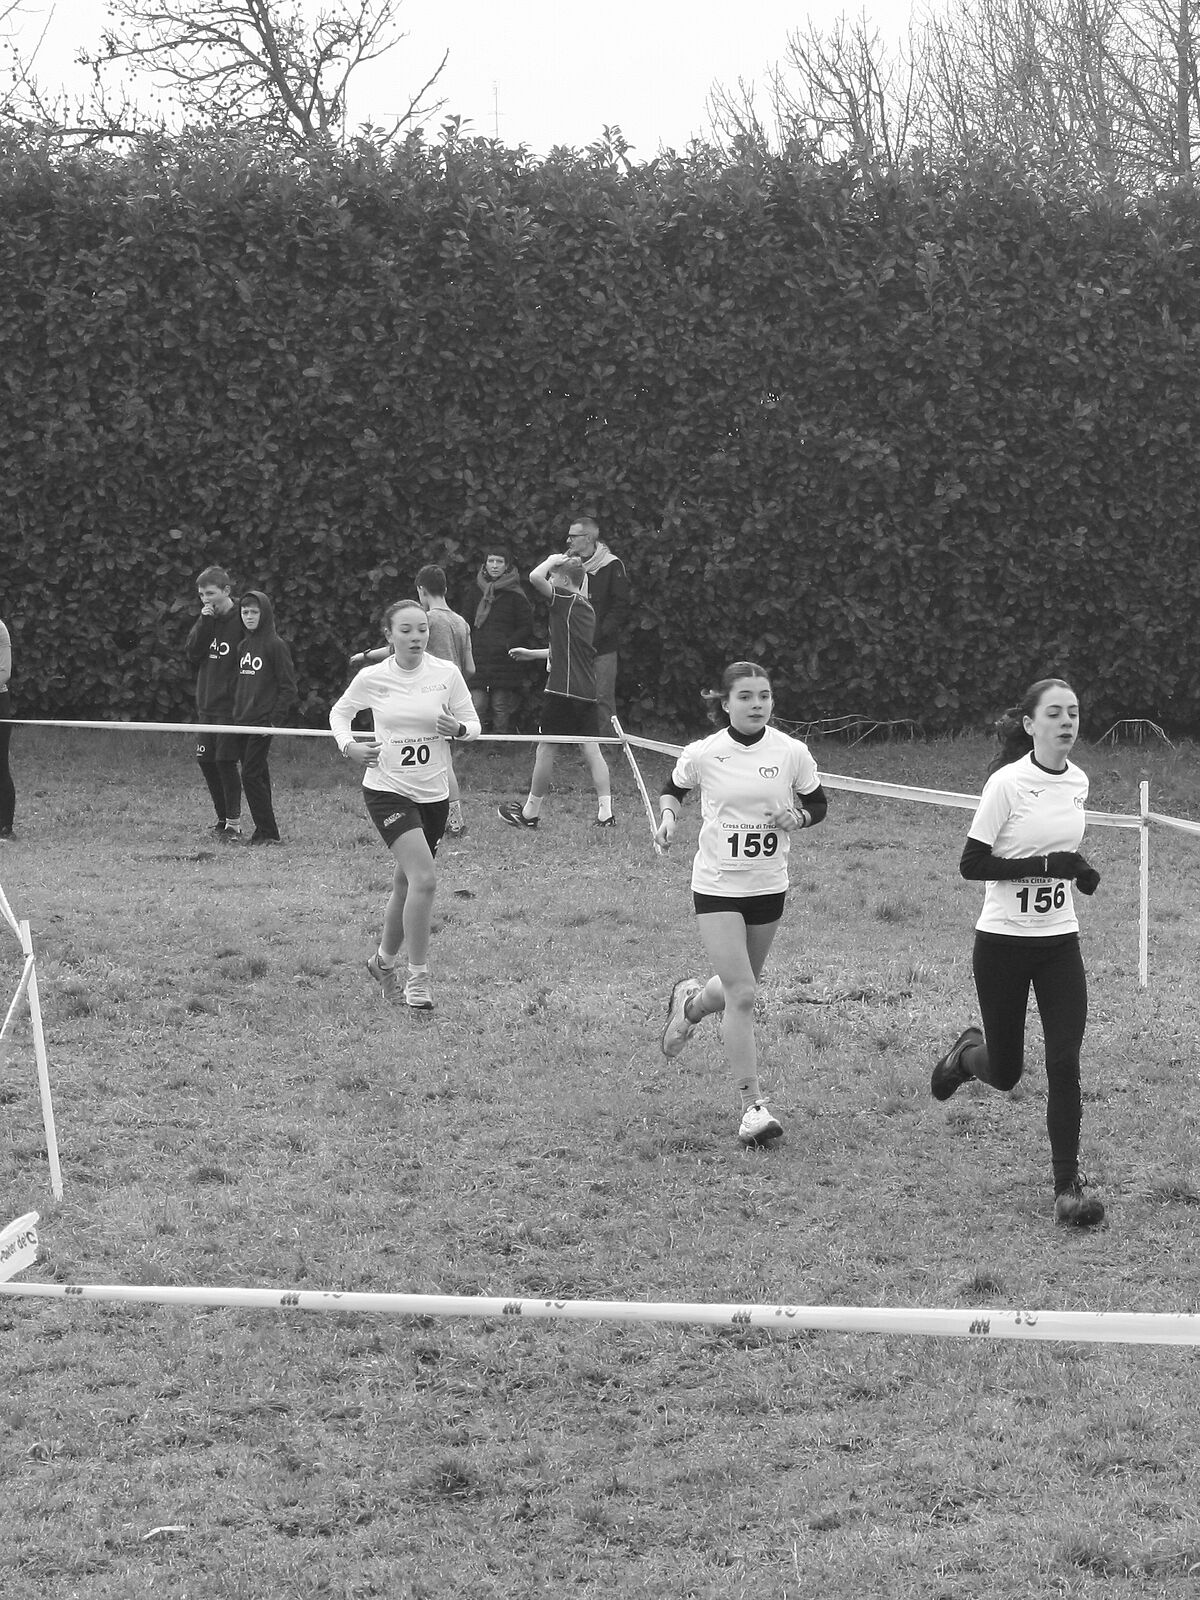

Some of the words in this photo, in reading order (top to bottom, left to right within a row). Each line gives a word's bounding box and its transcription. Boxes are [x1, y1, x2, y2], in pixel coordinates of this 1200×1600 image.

[401, 745, 430, 766] 20
[727, 832, 778, 858] 159
[1016, 882, 1065, 913] 156
